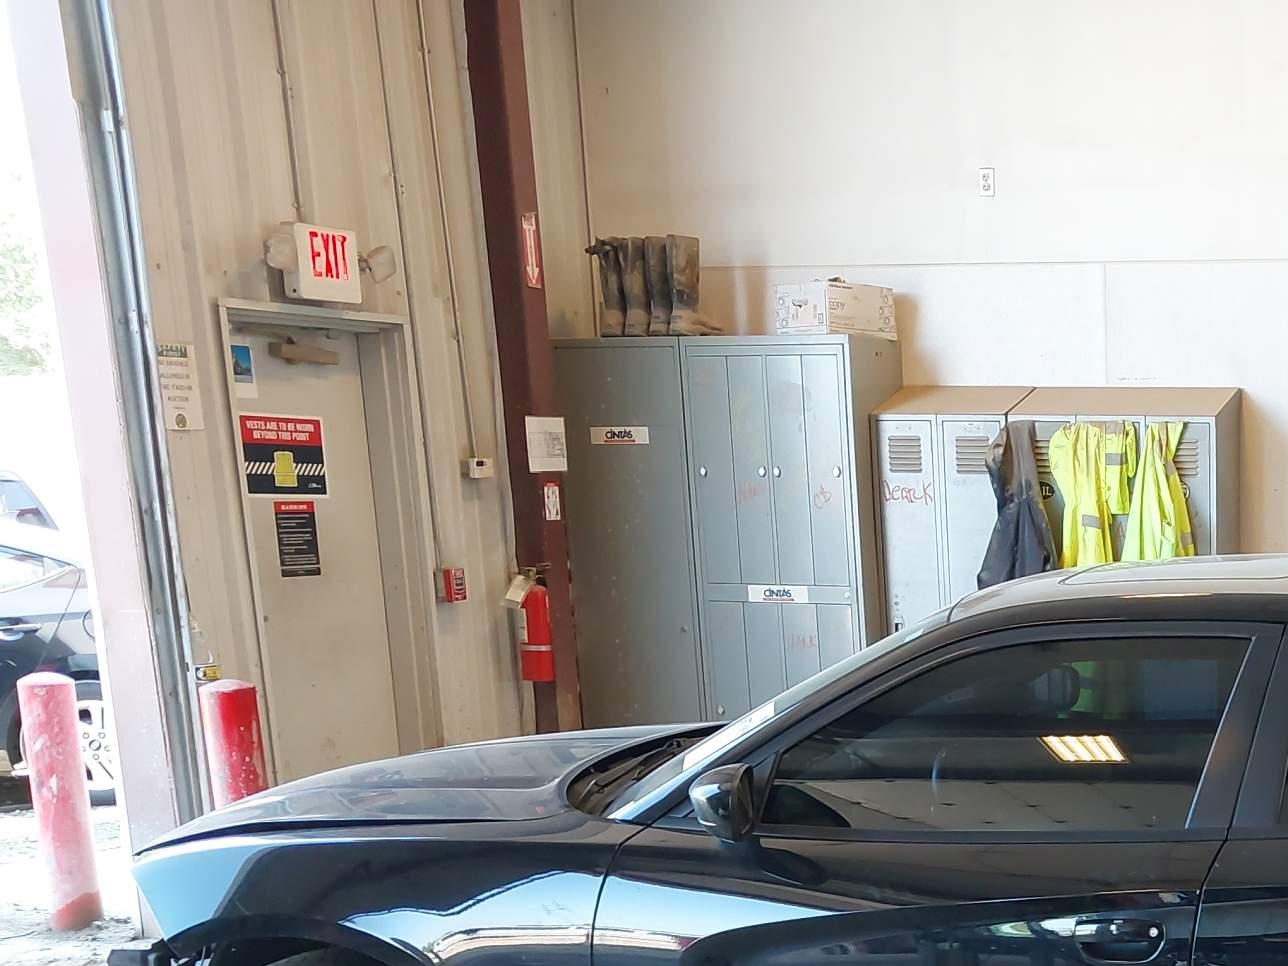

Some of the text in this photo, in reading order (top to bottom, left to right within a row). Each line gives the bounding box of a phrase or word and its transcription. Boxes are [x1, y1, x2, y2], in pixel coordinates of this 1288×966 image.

[308, 231, 349, 280] EXIT
[246, 421, 265, 430] VESTS
[266, 421, 278, 431] ARE
[279, 422, 287, 431] TO
[287, 422, 296, 432] BE
[253, 430, 309, 441] BEYOND THIS POINT
[764, 587, 792, 598] CINTAS
